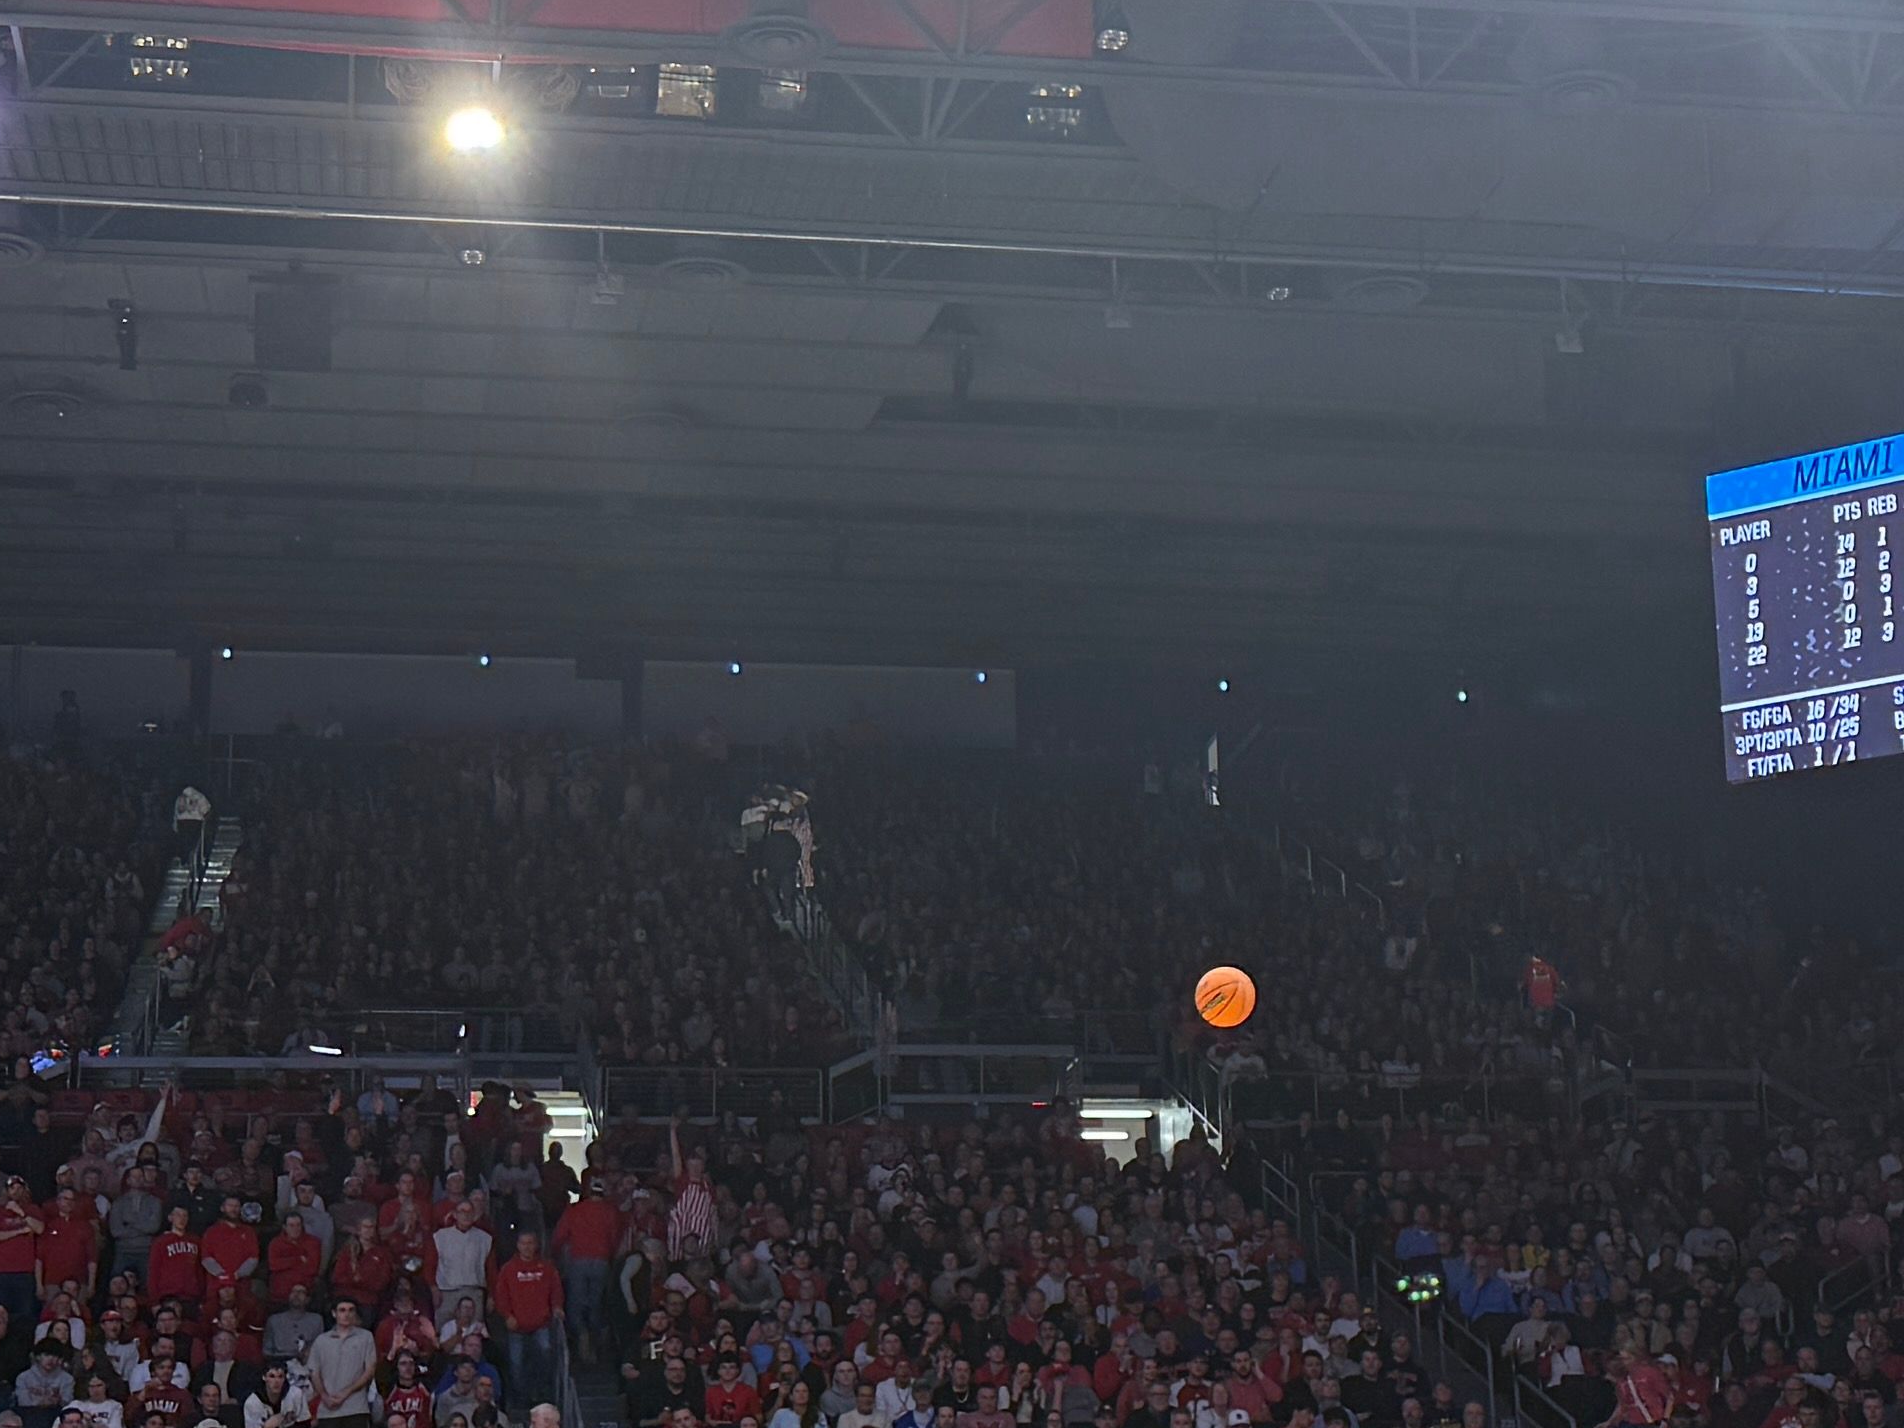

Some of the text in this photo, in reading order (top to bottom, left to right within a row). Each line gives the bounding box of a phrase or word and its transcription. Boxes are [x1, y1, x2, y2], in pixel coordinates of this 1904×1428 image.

[1793, 439, 1897, 494] MIAMI
[1719, 519, 1772, 547] PLAYER
[1832, 501, 1862, 523] PTS
[1867, 493, 1898, 517] REB
[1745, 553, 1758, 573] 0
[1836, 532, 1856, 555] 14
[1877, 525, 1888, 547] 1
[1836, 557, 1856, 580] 12
[1878, 550, 1892, 571] 2
[1842, 580, 1856, 602] 0
[1844, 603, 1857, 624] 0
[1882, 596, 1893, 618] 1
[1747, 644, 1768, 667] 22
[1843, 626, 1863, 649] 12
[1742, 704, 1793, 730] FG/FGA
[1806, 698, 1826, 722] 16
[1807, 722, 1827, 744] 10
[1747, 751, 1795, 779] FT/FTA
